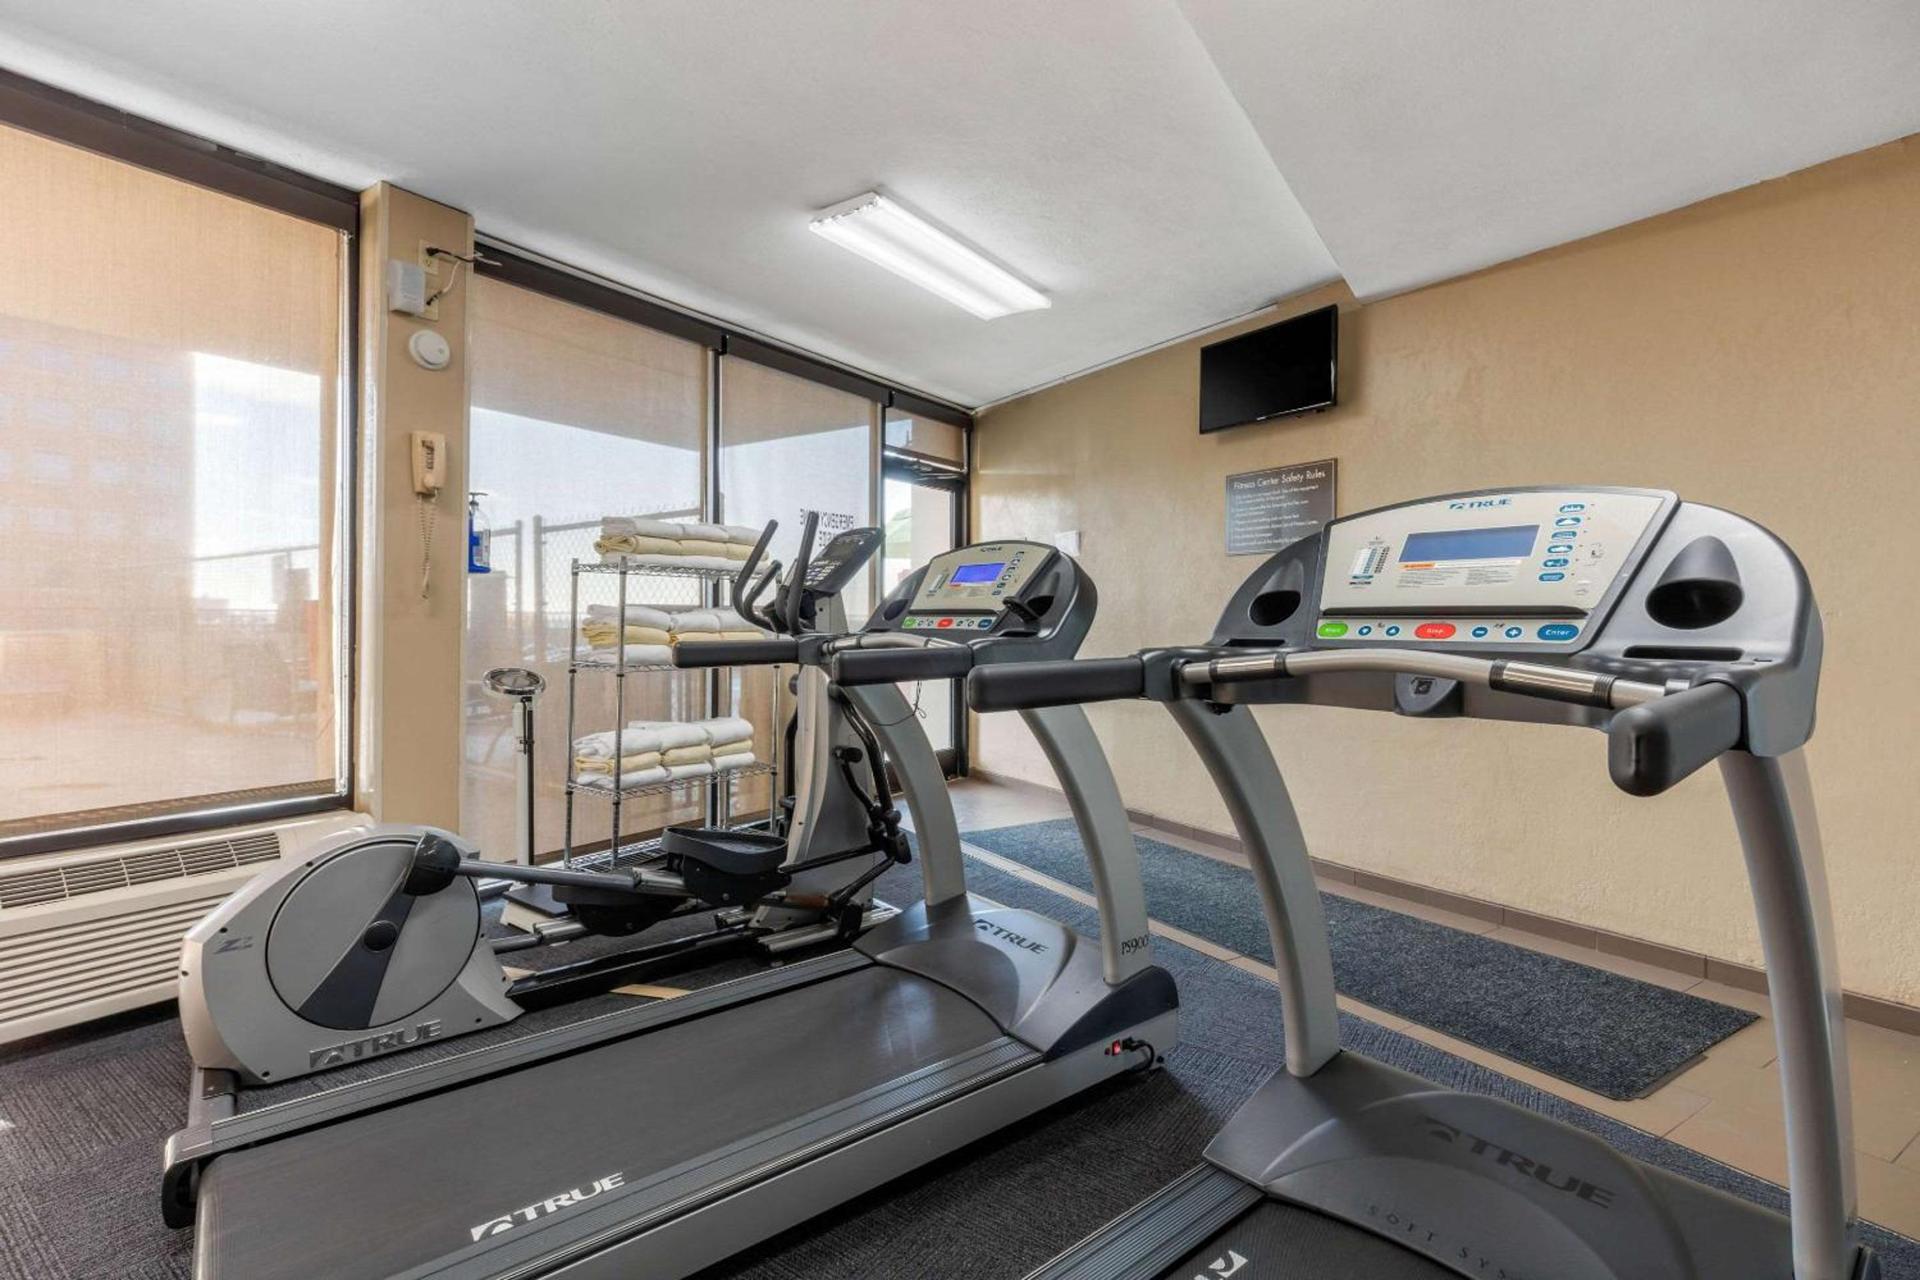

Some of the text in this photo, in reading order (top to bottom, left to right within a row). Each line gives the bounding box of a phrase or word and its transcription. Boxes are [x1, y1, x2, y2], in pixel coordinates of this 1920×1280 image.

[1257, 477, 1279, 488] Center
[1281, 471, 1304, 484] Safety
[1306, 468, 1326, 480] Rules
[1469, 498, 1512, 509] TRUE
[1545, 628, 1571, 636] Enter
[993, 927, 1049, 955] TRUE
[346, 1019, 441, 1056] TRUE
[1471, 1136, 1617, 1209] TRUE
[513, 1171, 625, 1221] TRUE
